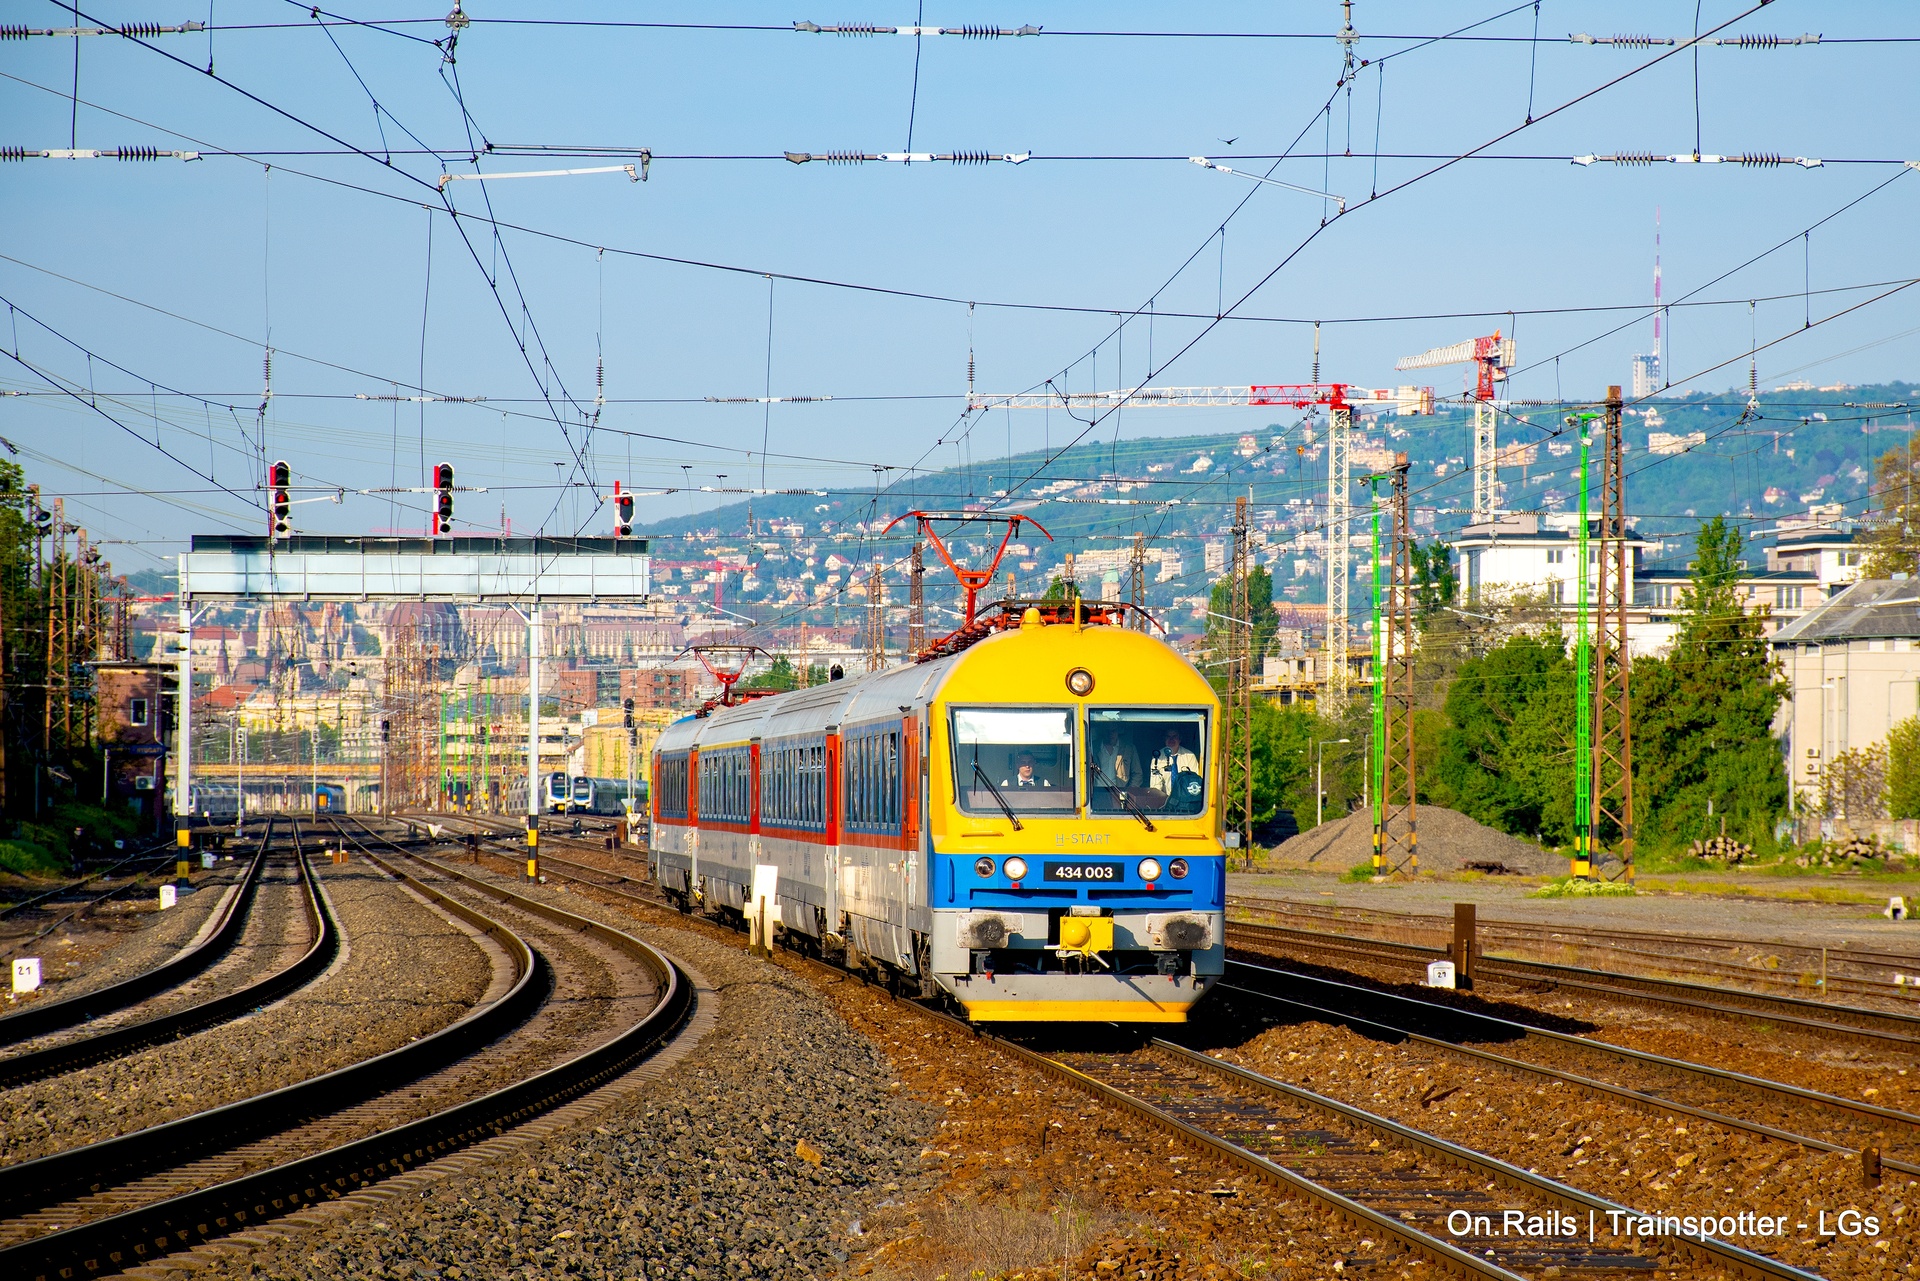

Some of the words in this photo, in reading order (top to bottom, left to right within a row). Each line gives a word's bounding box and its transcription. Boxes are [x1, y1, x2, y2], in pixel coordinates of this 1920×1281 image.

[1055, 833, 1111, 846] H-START
[1055, 866, 1083, 879] 434
[1084, 866, 1113, 879] 003
[18, 966, 31, 976] 21
